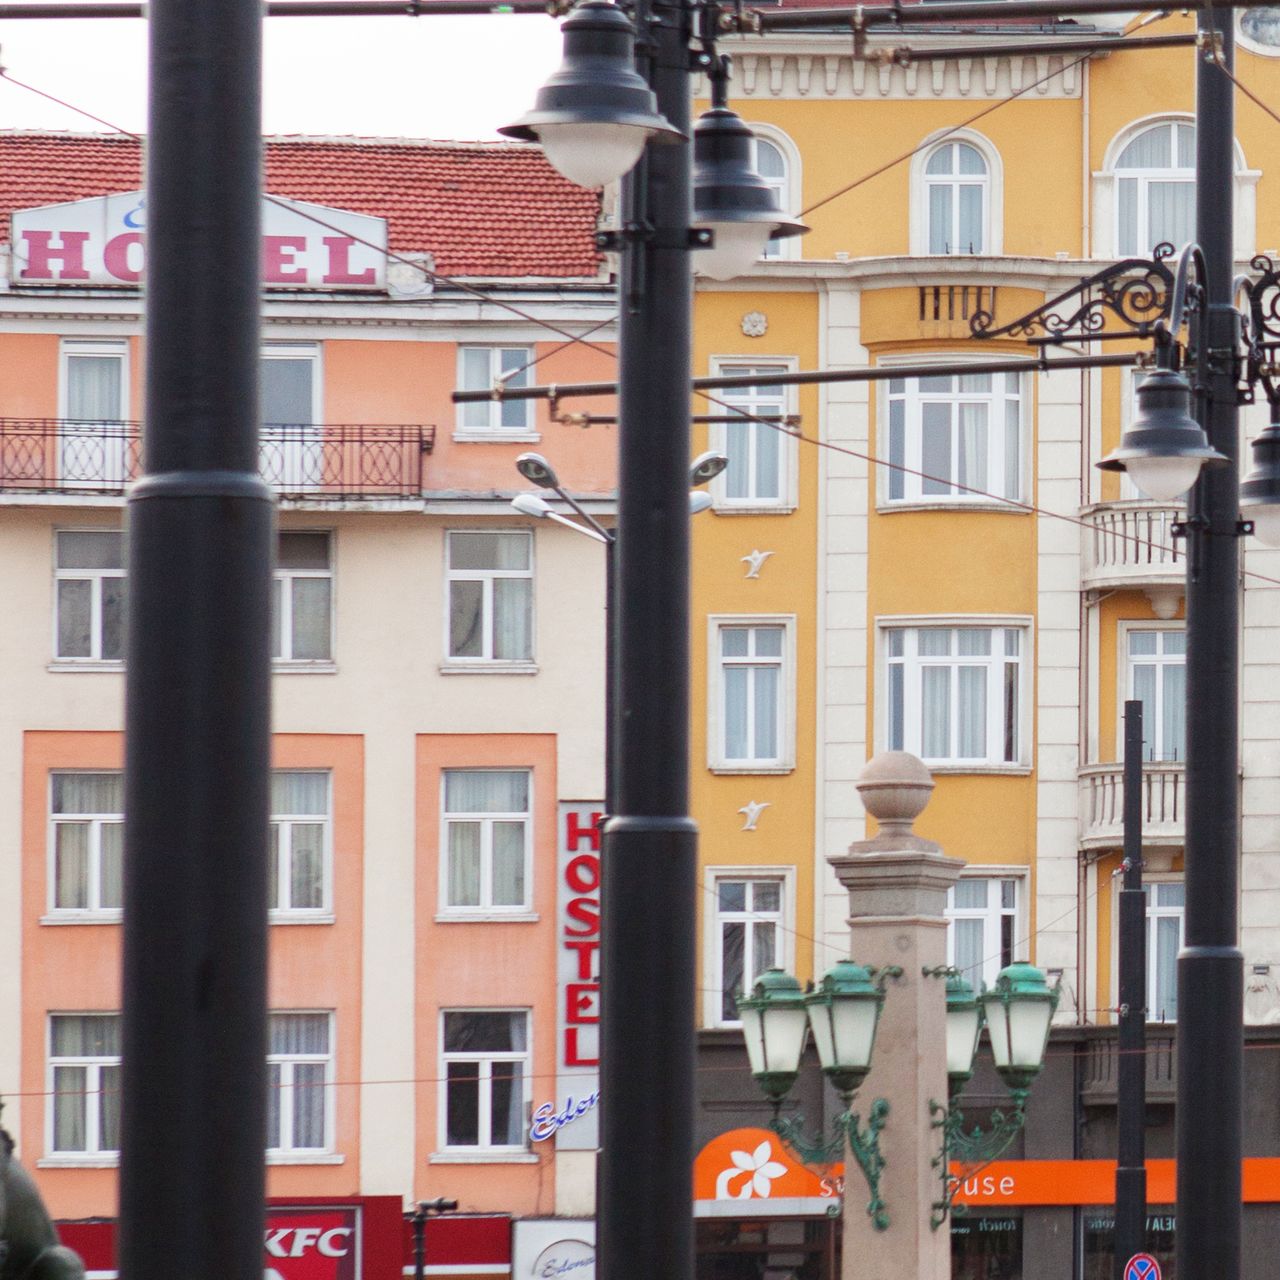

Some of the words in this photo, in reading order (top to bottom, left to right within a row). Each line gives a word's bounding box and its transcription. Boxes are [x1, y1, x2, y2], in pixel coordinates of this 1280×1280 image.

[20, 229, 377, 285] HOEL
[945, 1175, 1016, 1197] ouse
[264, 1227, 353, 1258] KFC
